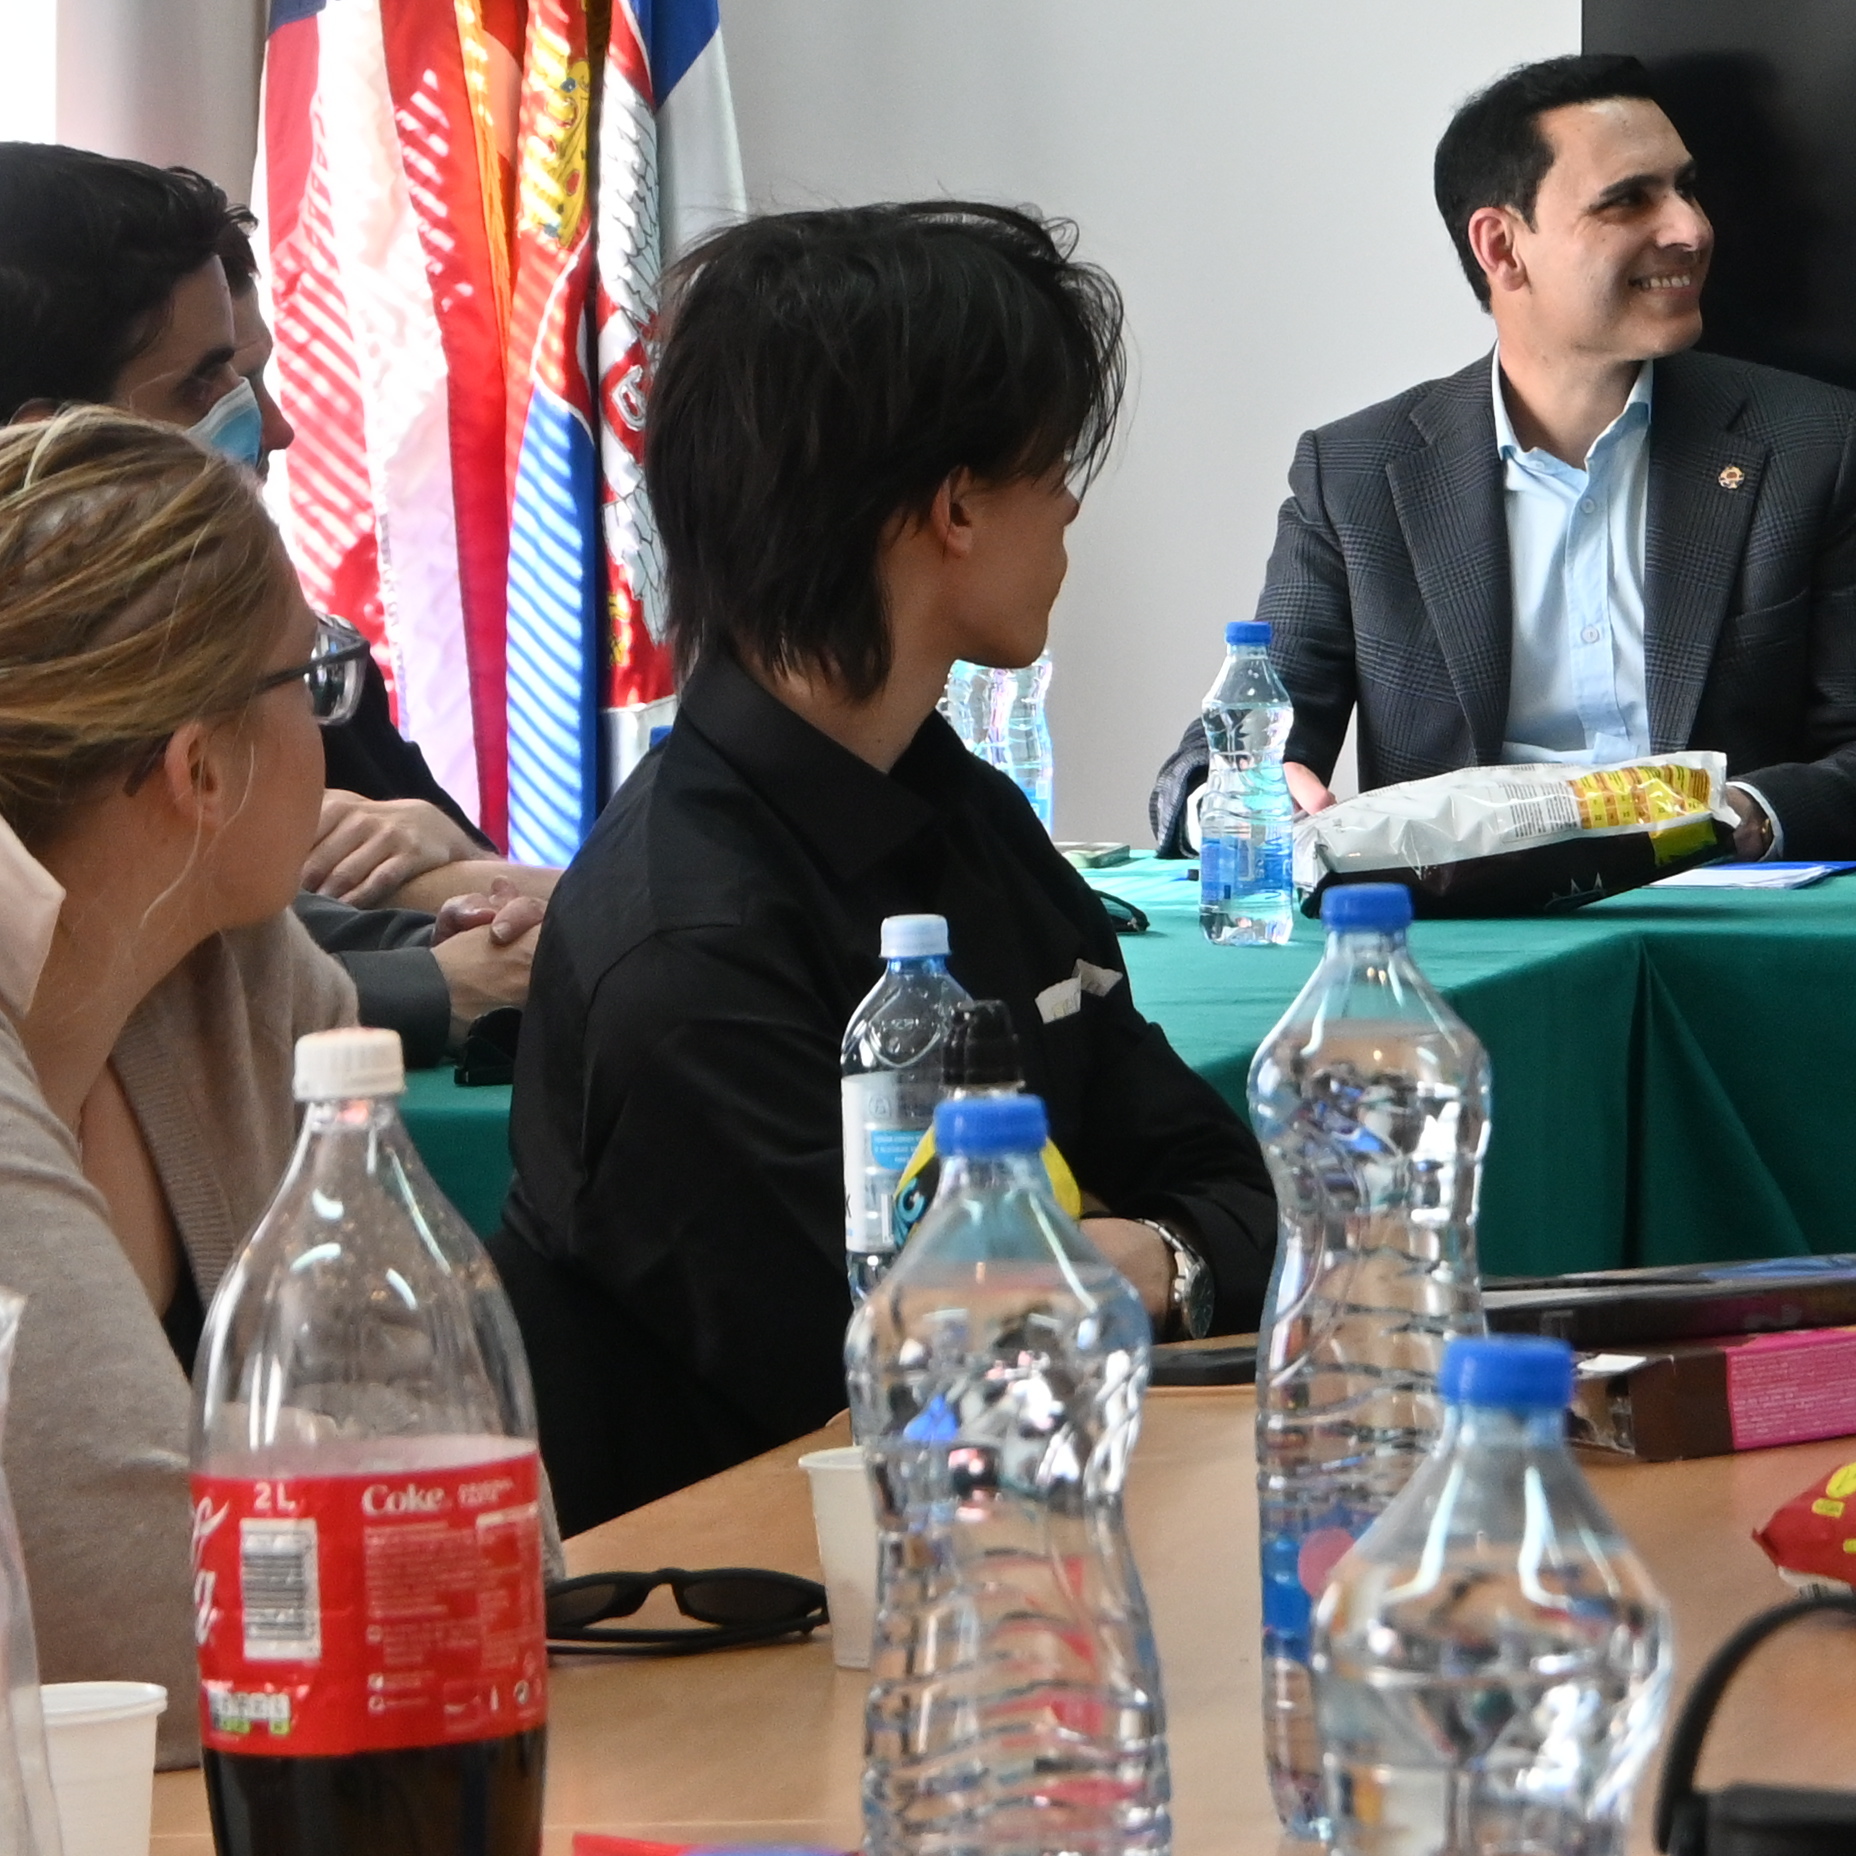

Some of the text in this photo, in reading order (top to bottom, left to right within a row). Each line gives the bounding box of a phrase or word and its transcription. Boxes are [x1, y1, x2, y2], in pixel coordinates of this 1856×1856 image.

[253, 1482, 297, 1512] 2 L
[361, 1483, 446, 1517] Coke
